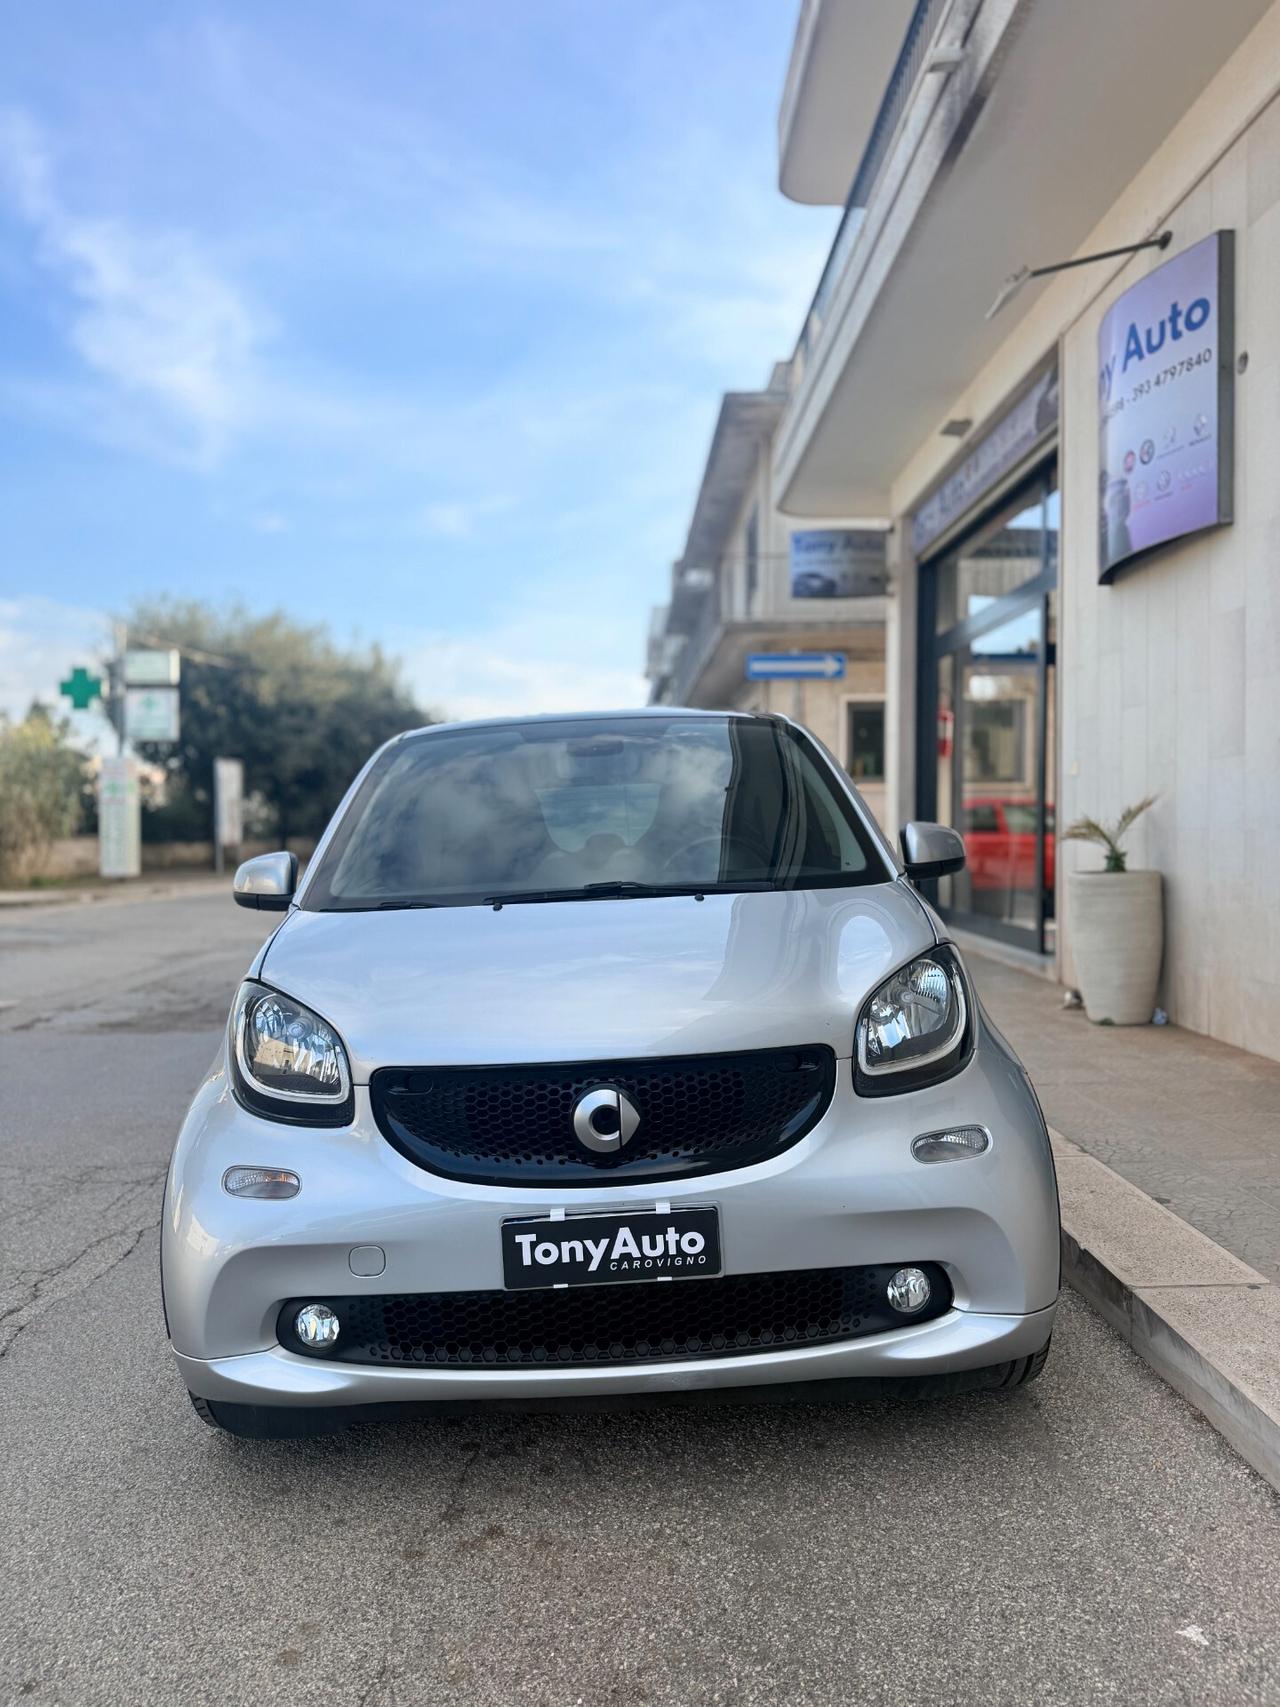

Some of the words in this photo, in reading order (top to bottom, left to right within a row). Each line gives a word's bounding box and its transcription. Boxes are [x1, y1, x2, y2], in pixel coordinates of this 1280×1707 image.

[1122, 297, 1211, 375] Auto
[1153, 347, 1213, 387] 4797840
[609, 1255, 707, 1271] CAROVIGNO
